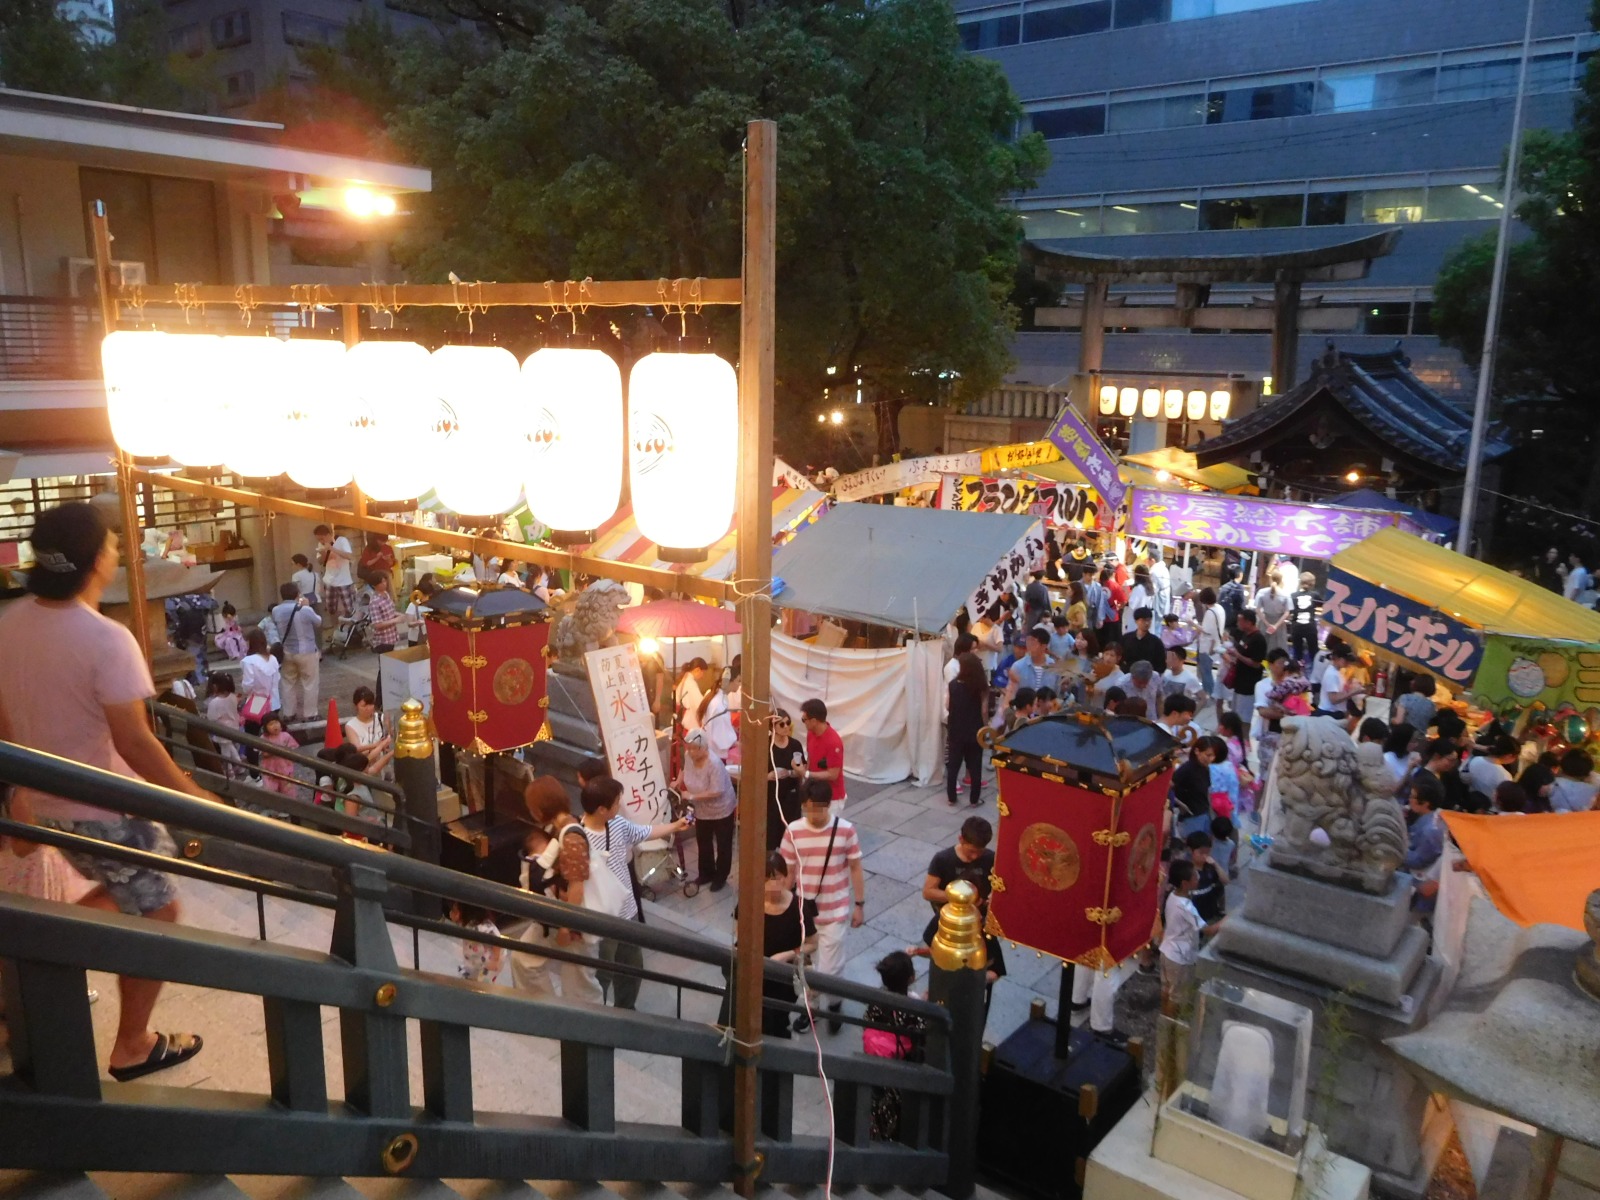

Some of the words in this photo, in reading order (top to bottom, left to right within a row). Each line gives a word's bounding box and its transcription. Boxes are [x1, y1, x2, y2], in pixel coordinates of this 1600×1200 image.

[966, 480, 1099, 524] フランクフルト
[1322, 579, 1474, 681] スーパーボール
[610, 689, 637, 722] 氷
